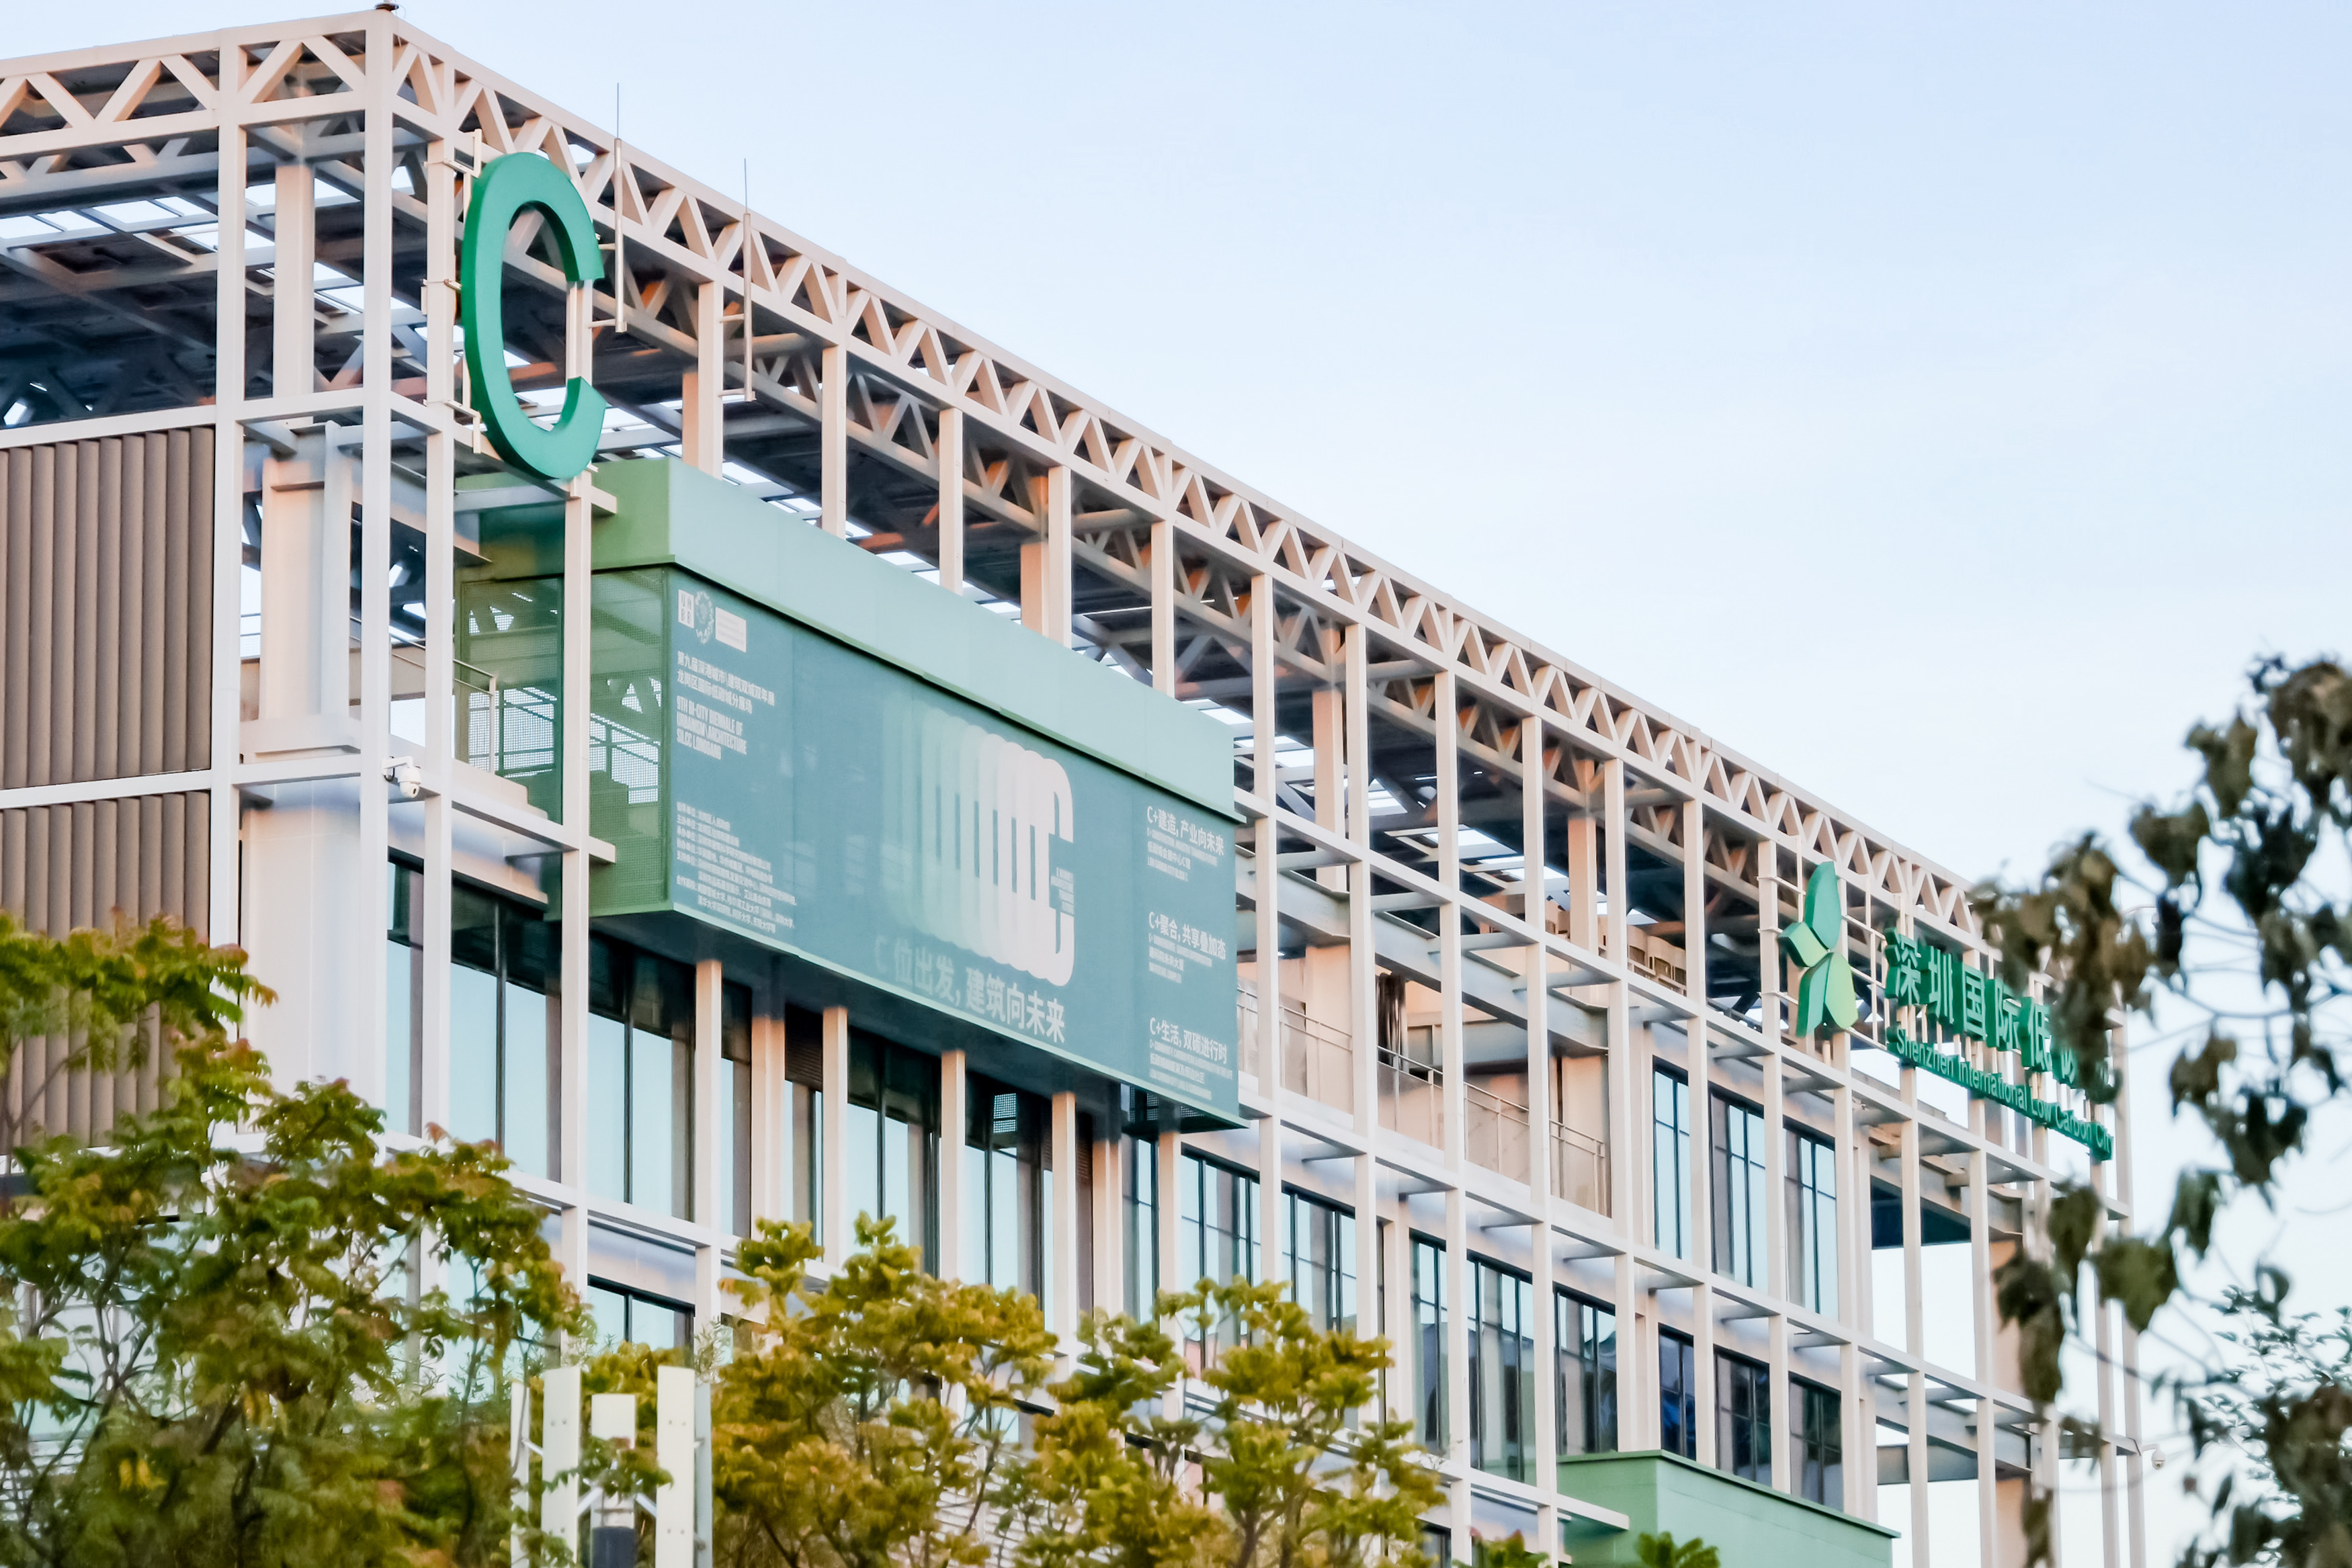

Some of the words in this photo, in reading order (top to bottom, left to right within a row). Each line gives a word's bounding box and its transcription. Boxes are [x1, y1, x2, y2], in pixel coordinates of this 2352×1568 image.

[462, 152, 606, 478] C
[1884, 927, 2110, 1086] 深圳国际低
[1890, 1027, 1956, 1077] Shenzhen
[1958, 1059, 2027, 1113] International
[2031, 1098, 2050, 1123] Low
[2054, 1105, 2092, 1141] Carbon
[2095, 1121, 2114, 1157] City
